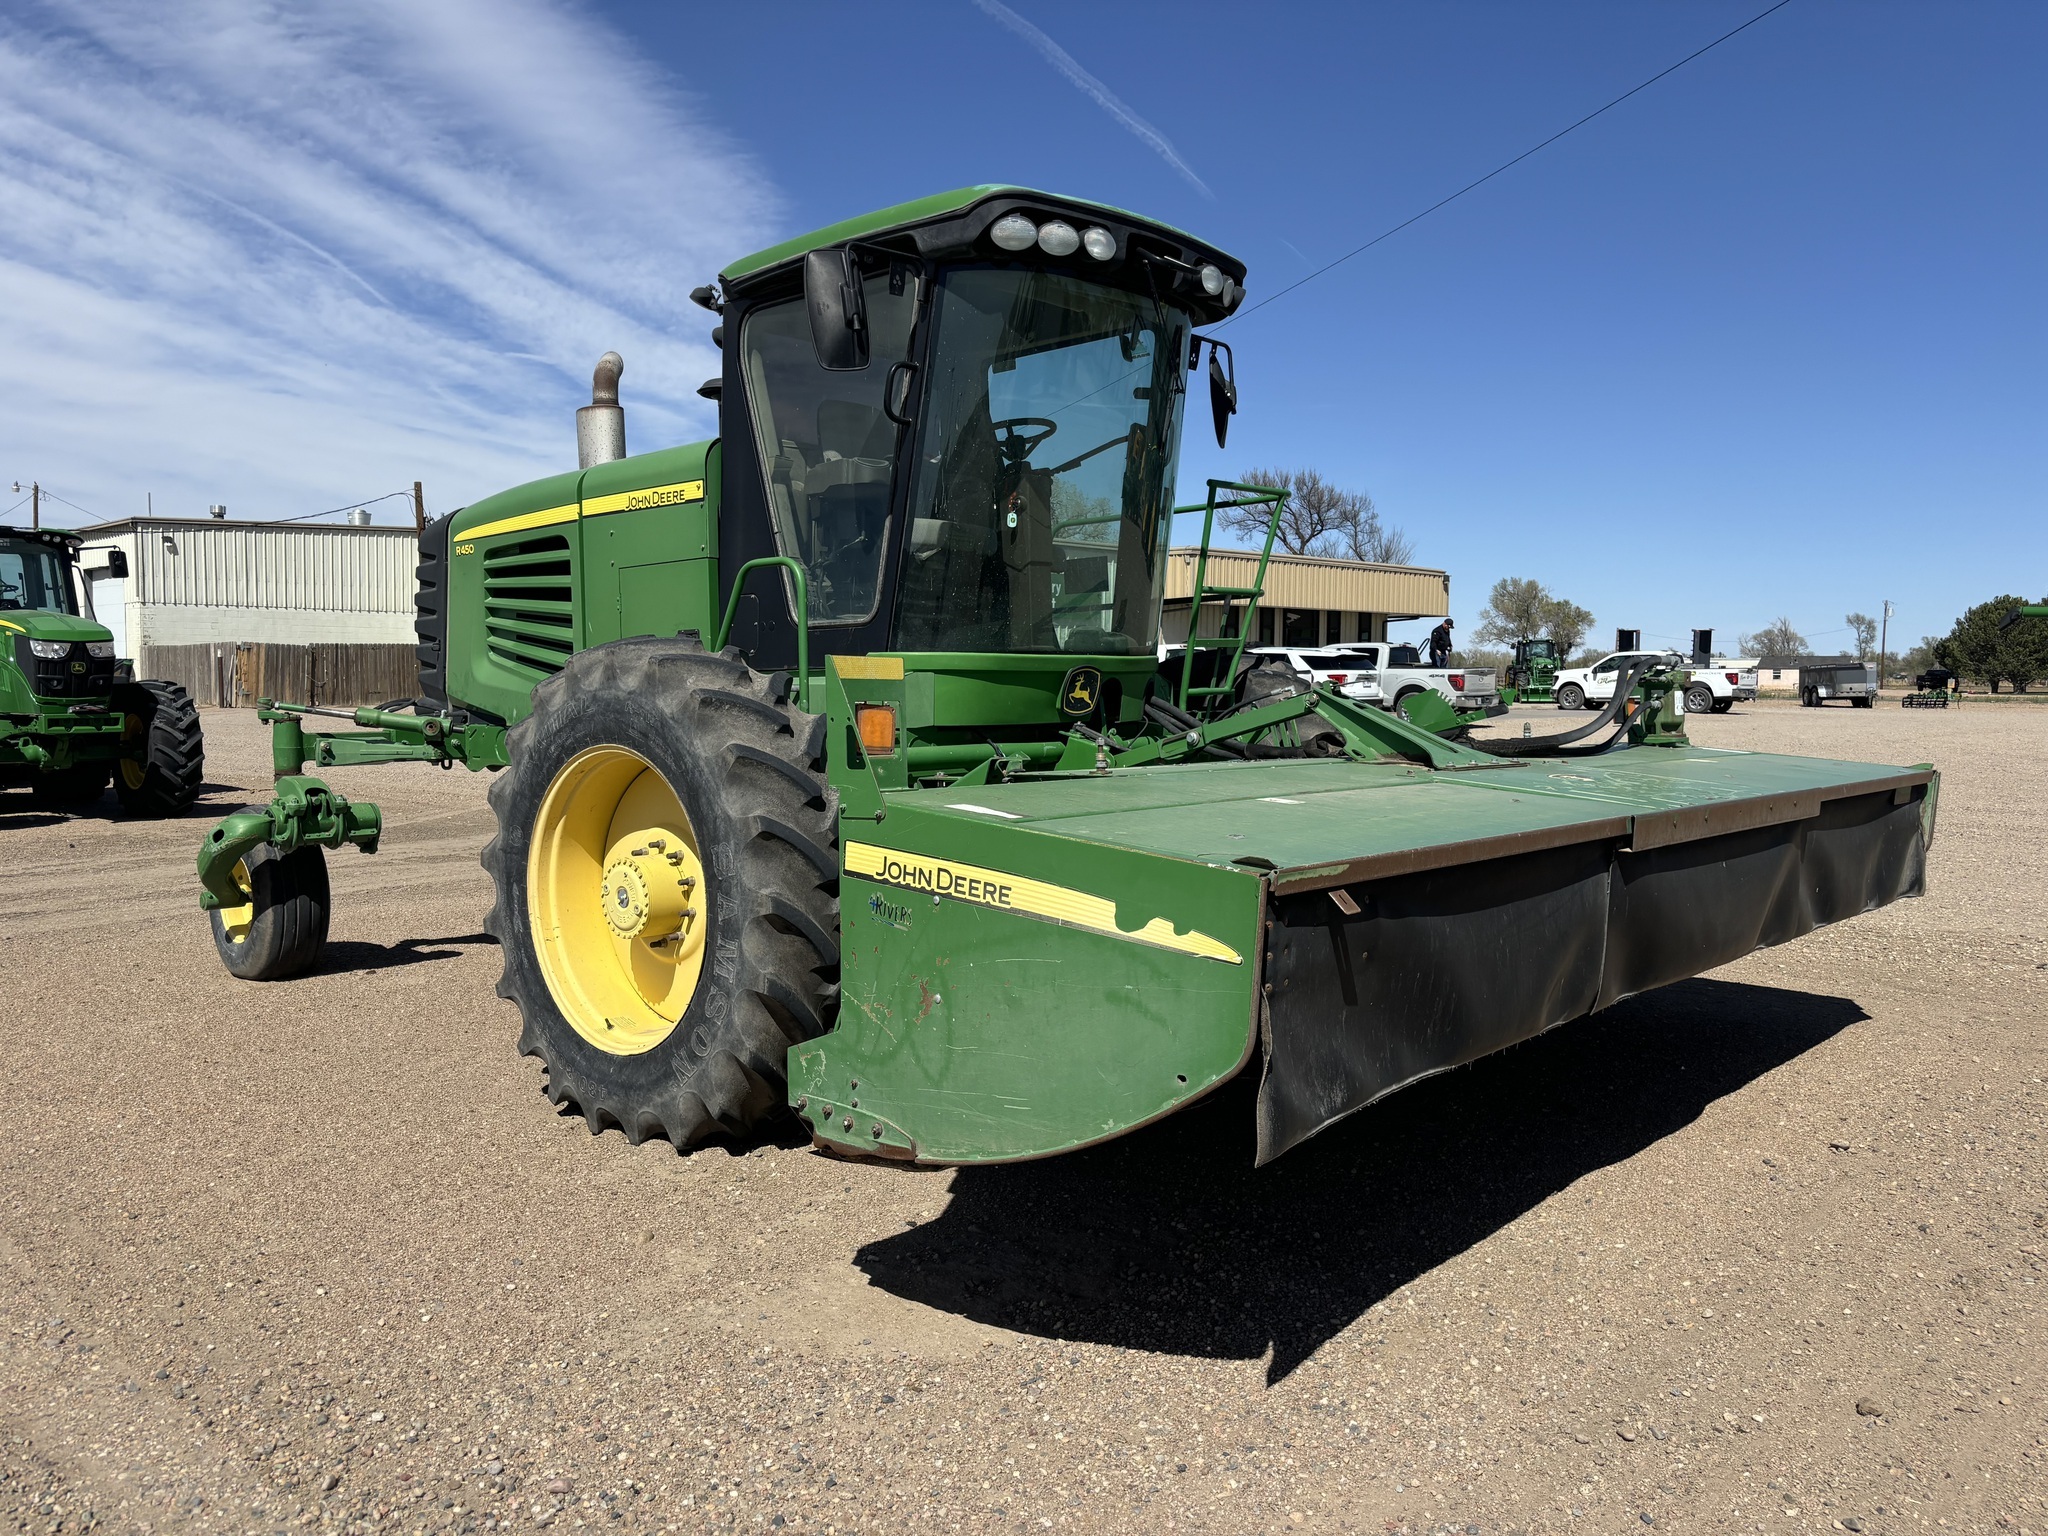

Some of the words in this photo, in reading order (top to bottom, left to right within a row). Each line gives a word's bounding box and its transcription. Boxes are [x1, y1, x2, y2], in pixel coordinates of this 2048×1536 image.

[625, 494, 650, 510] JOHN
[652, 489, 685, 503] DEERE
[456, 544, 474, 556] R450
[875, 856, 932, 888] JOHN
[936, 867, 1012, 905] DEERE
[671, 842, 740, 1088] SAMSON
